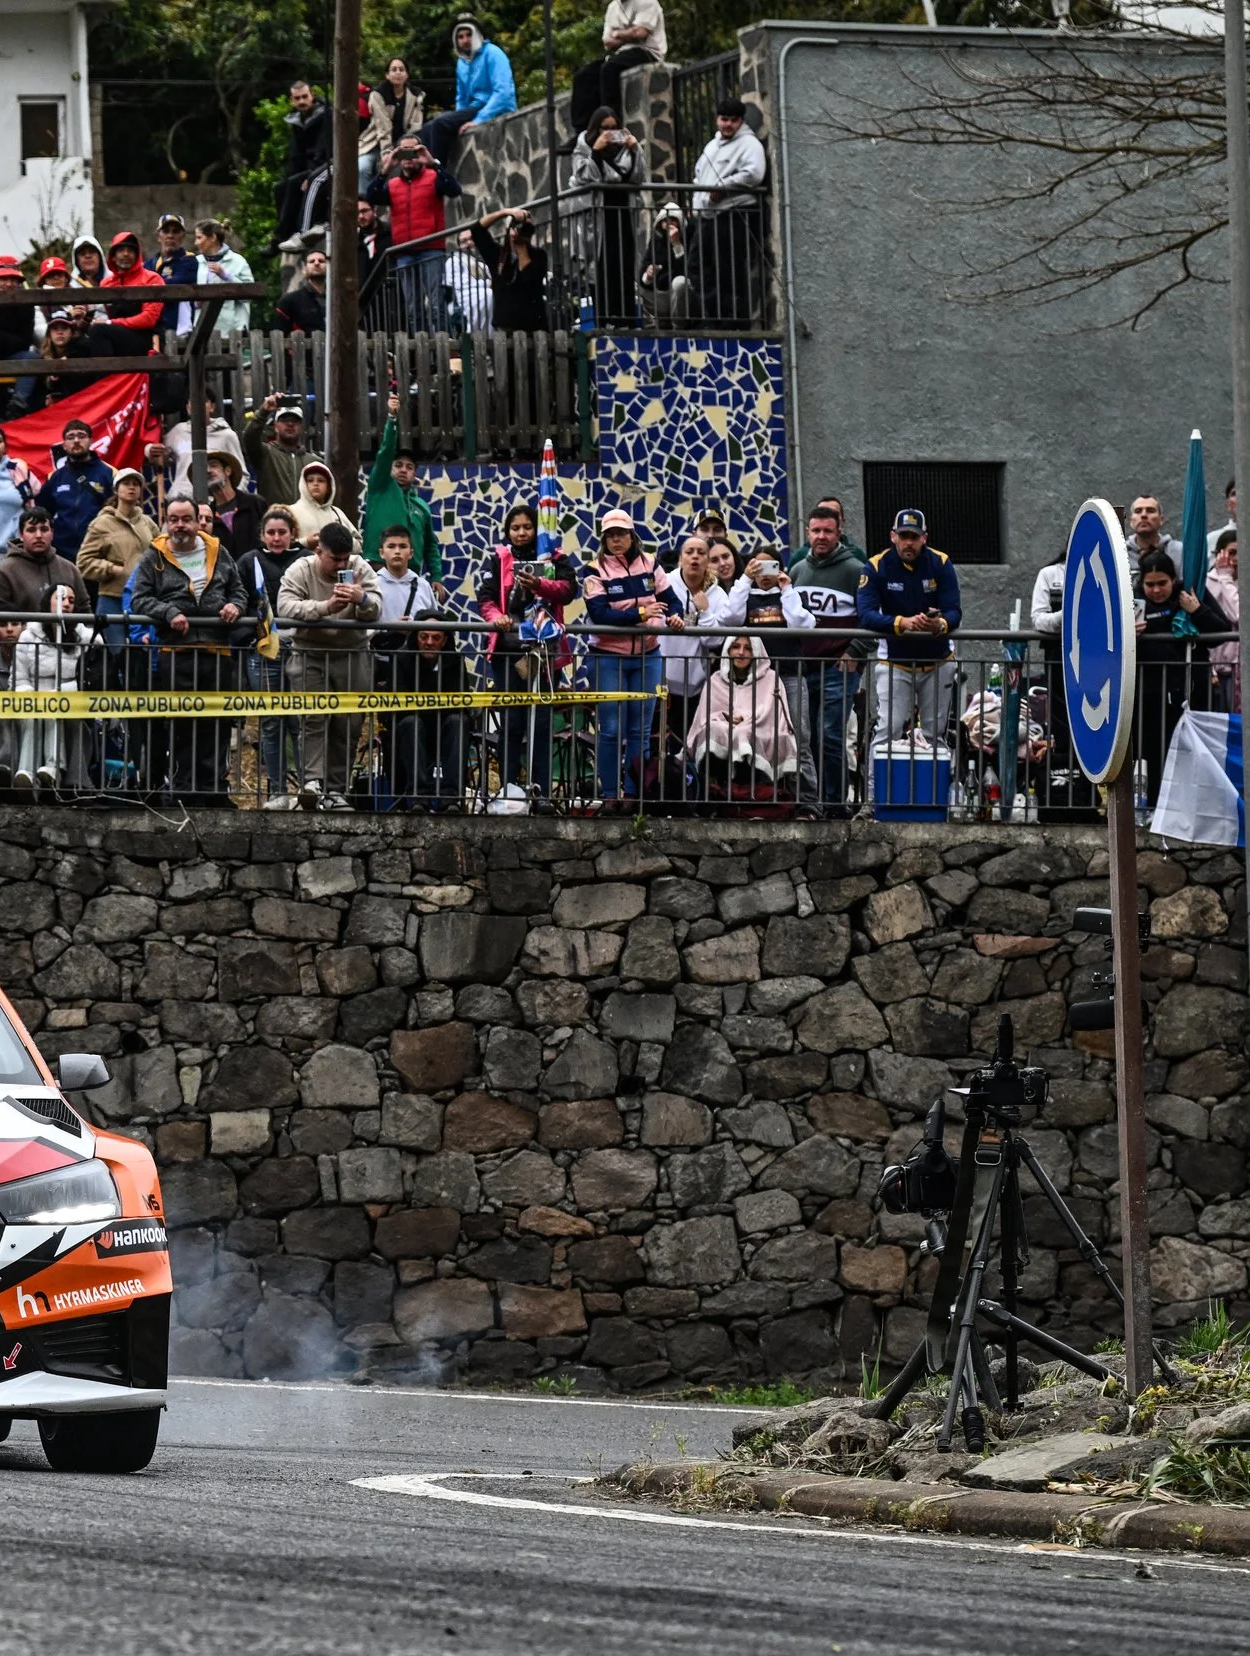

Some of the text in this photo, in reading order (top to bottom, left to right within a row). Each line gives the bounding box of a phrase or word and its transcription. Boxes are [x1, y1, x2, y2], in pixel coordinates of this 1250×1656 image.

[2, 697, 70, 713] PUBLICO
[89, 696, 205, 712] ZONA PUBLICO
[224, 695, 340, 711] ZONA PUBLICO
[358, 694, 473, 709] ZONA PUBLICO
[491, 694, 608, 705] ZONA PUBLICO
[53, 1278, 146, 1311] HYRMASKINER
